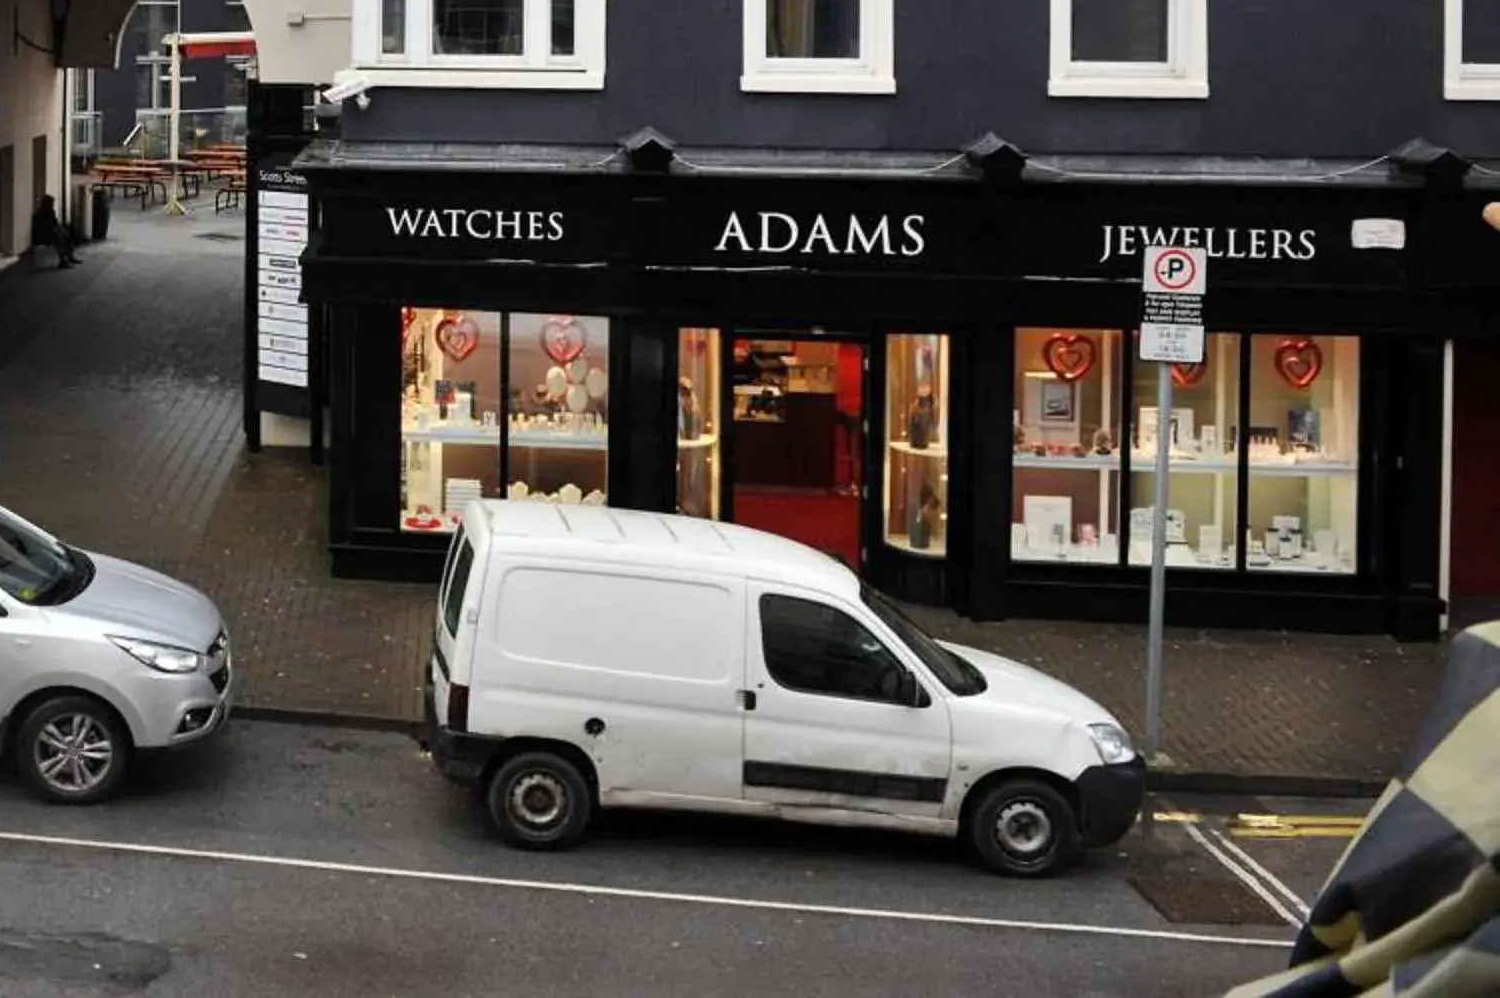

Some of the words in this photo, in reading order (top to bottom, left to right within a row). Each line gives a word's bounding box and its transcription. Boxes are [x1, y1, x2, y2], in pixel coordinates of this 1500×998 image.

[385, 207, 565, 241] WATCHES
[713, 210, 926, 257] ADAMS
[1100, 224, 1317, 262] JEWELLERS
[1167, 257, 1185, 280] P
